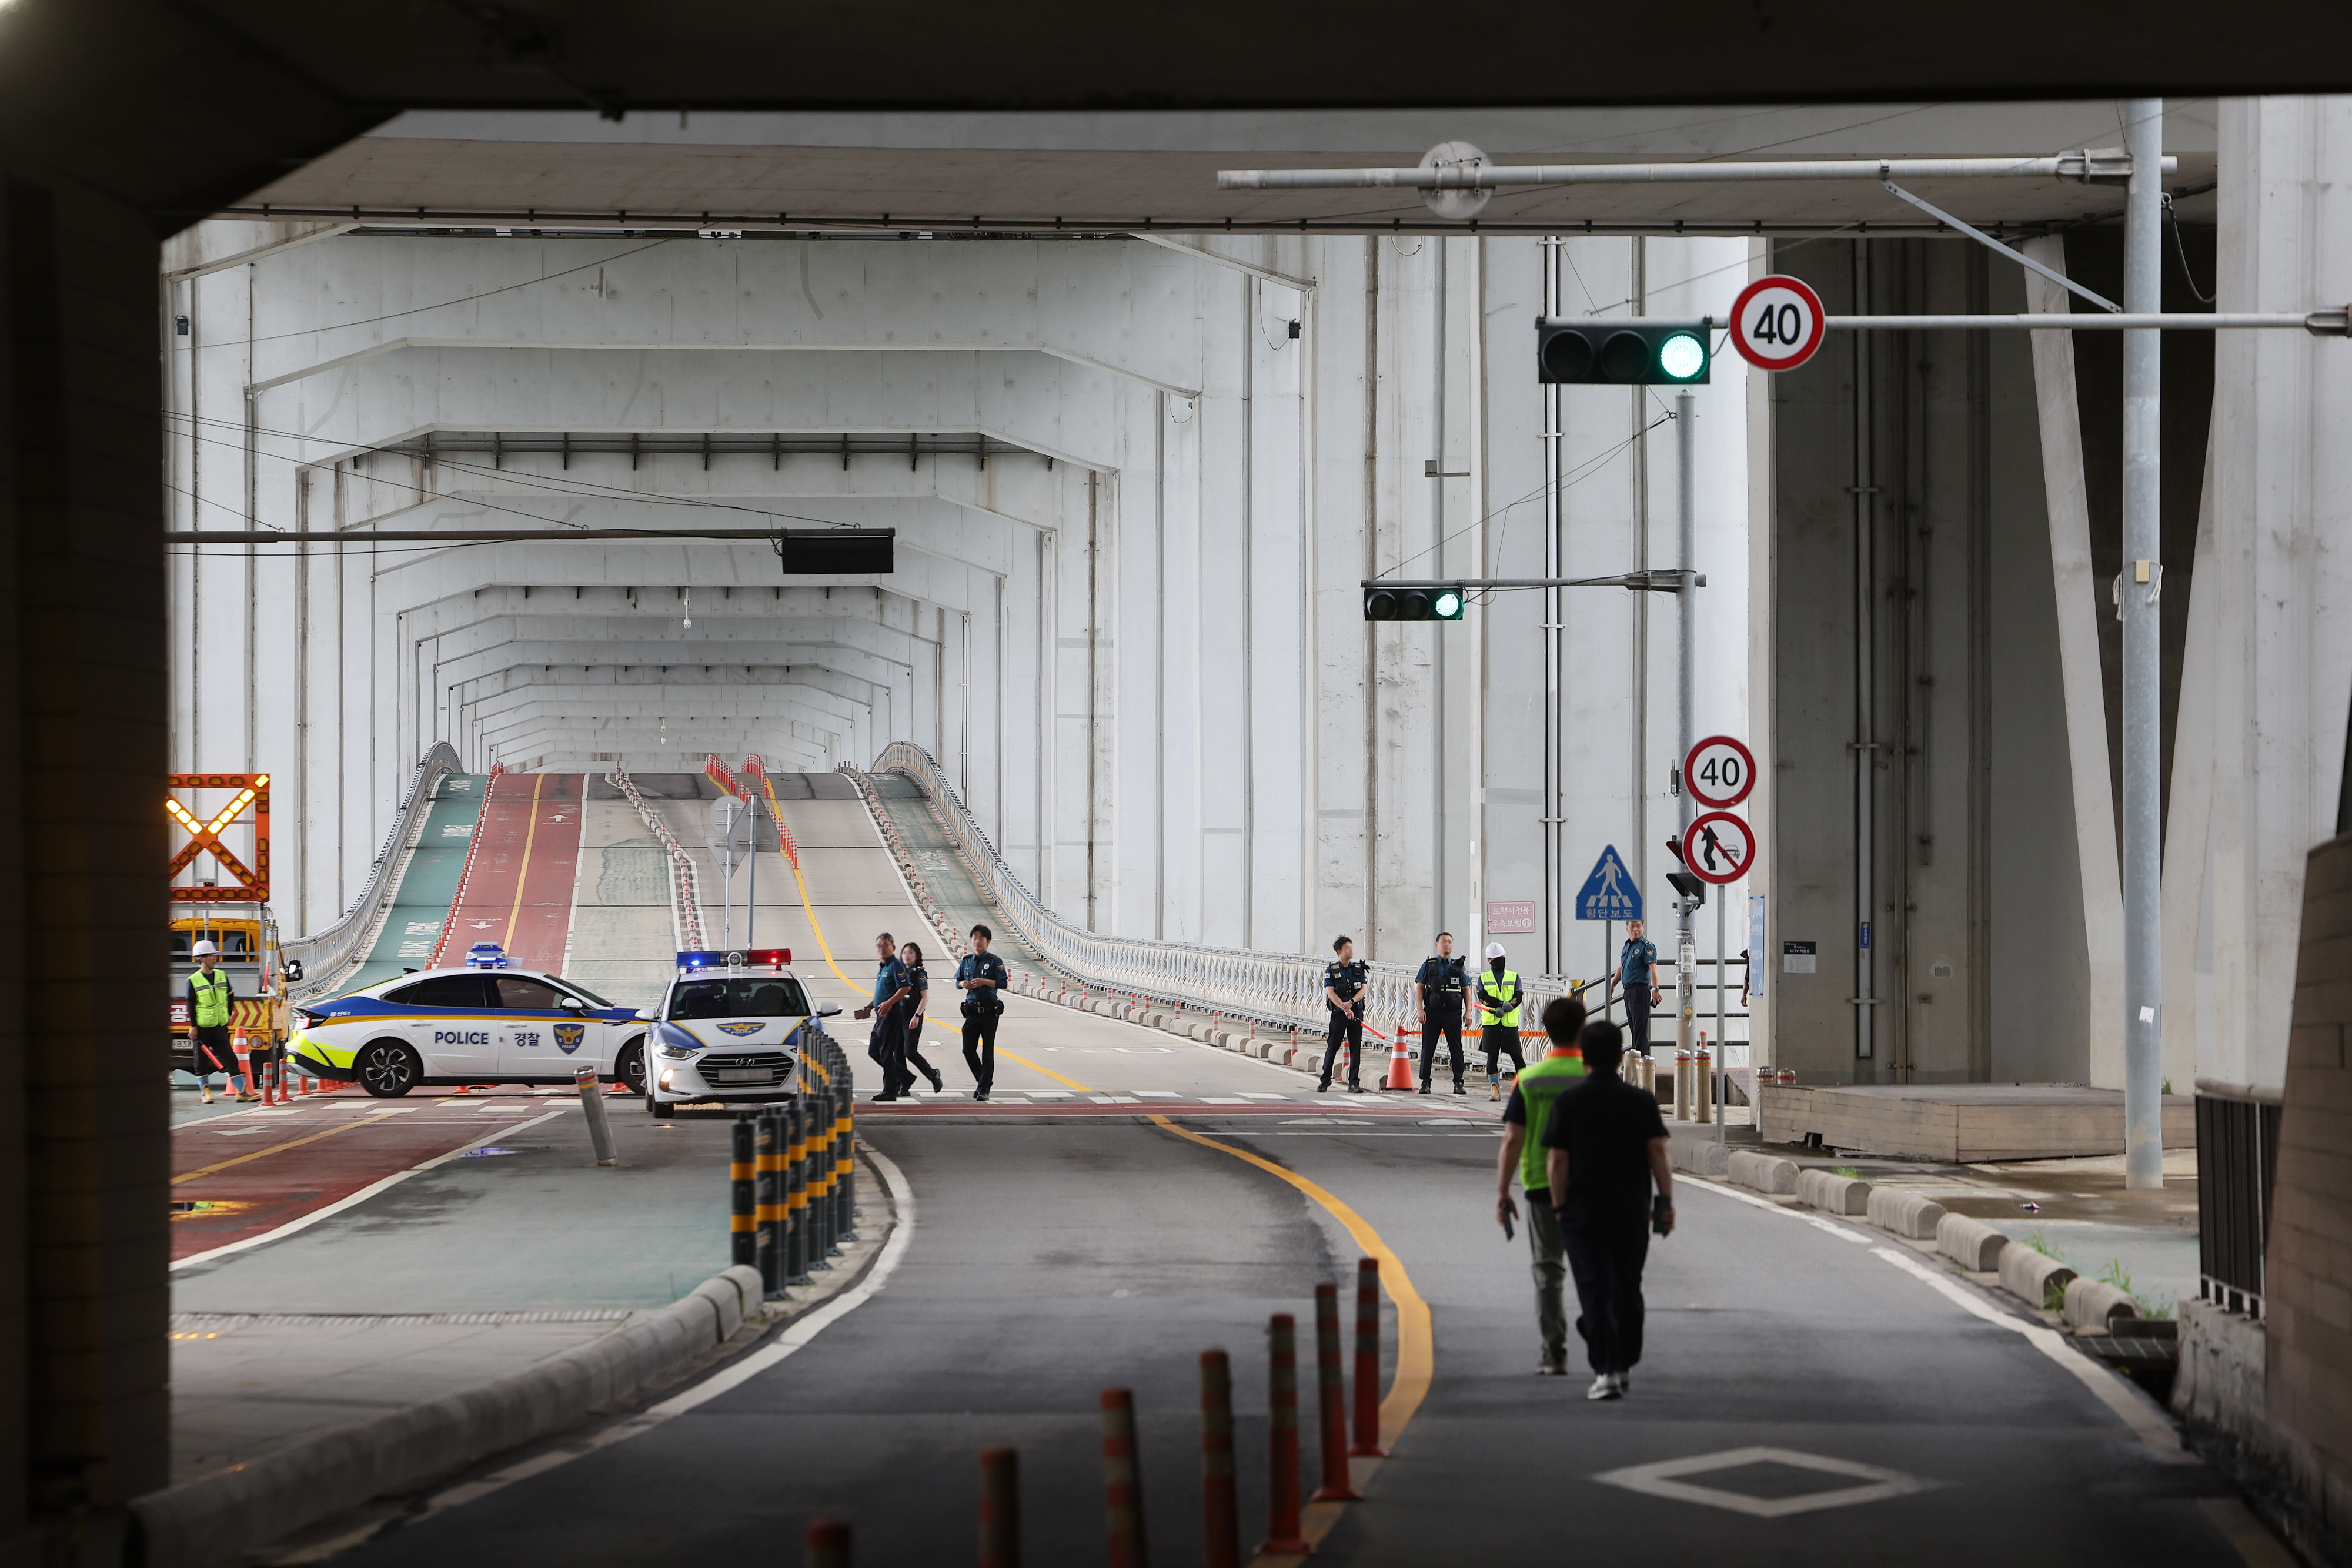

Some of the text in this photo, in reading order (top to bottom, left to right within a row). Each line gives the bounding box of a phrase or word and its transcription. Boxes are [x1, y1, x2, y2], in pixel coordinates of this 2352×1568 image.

[1753, 303, 1801, 346] 40
[1700, 757, 1740, 787] 40
[1492, 905, 1530, 915] 보행자전용
[1586, 908, 1633, 918] 횡단보도
[1491, 919, 1522, 928] 우측보행
[435, 1031, 489, 1045] POLICE
[514, 1032, 540, 1047] 경찰
